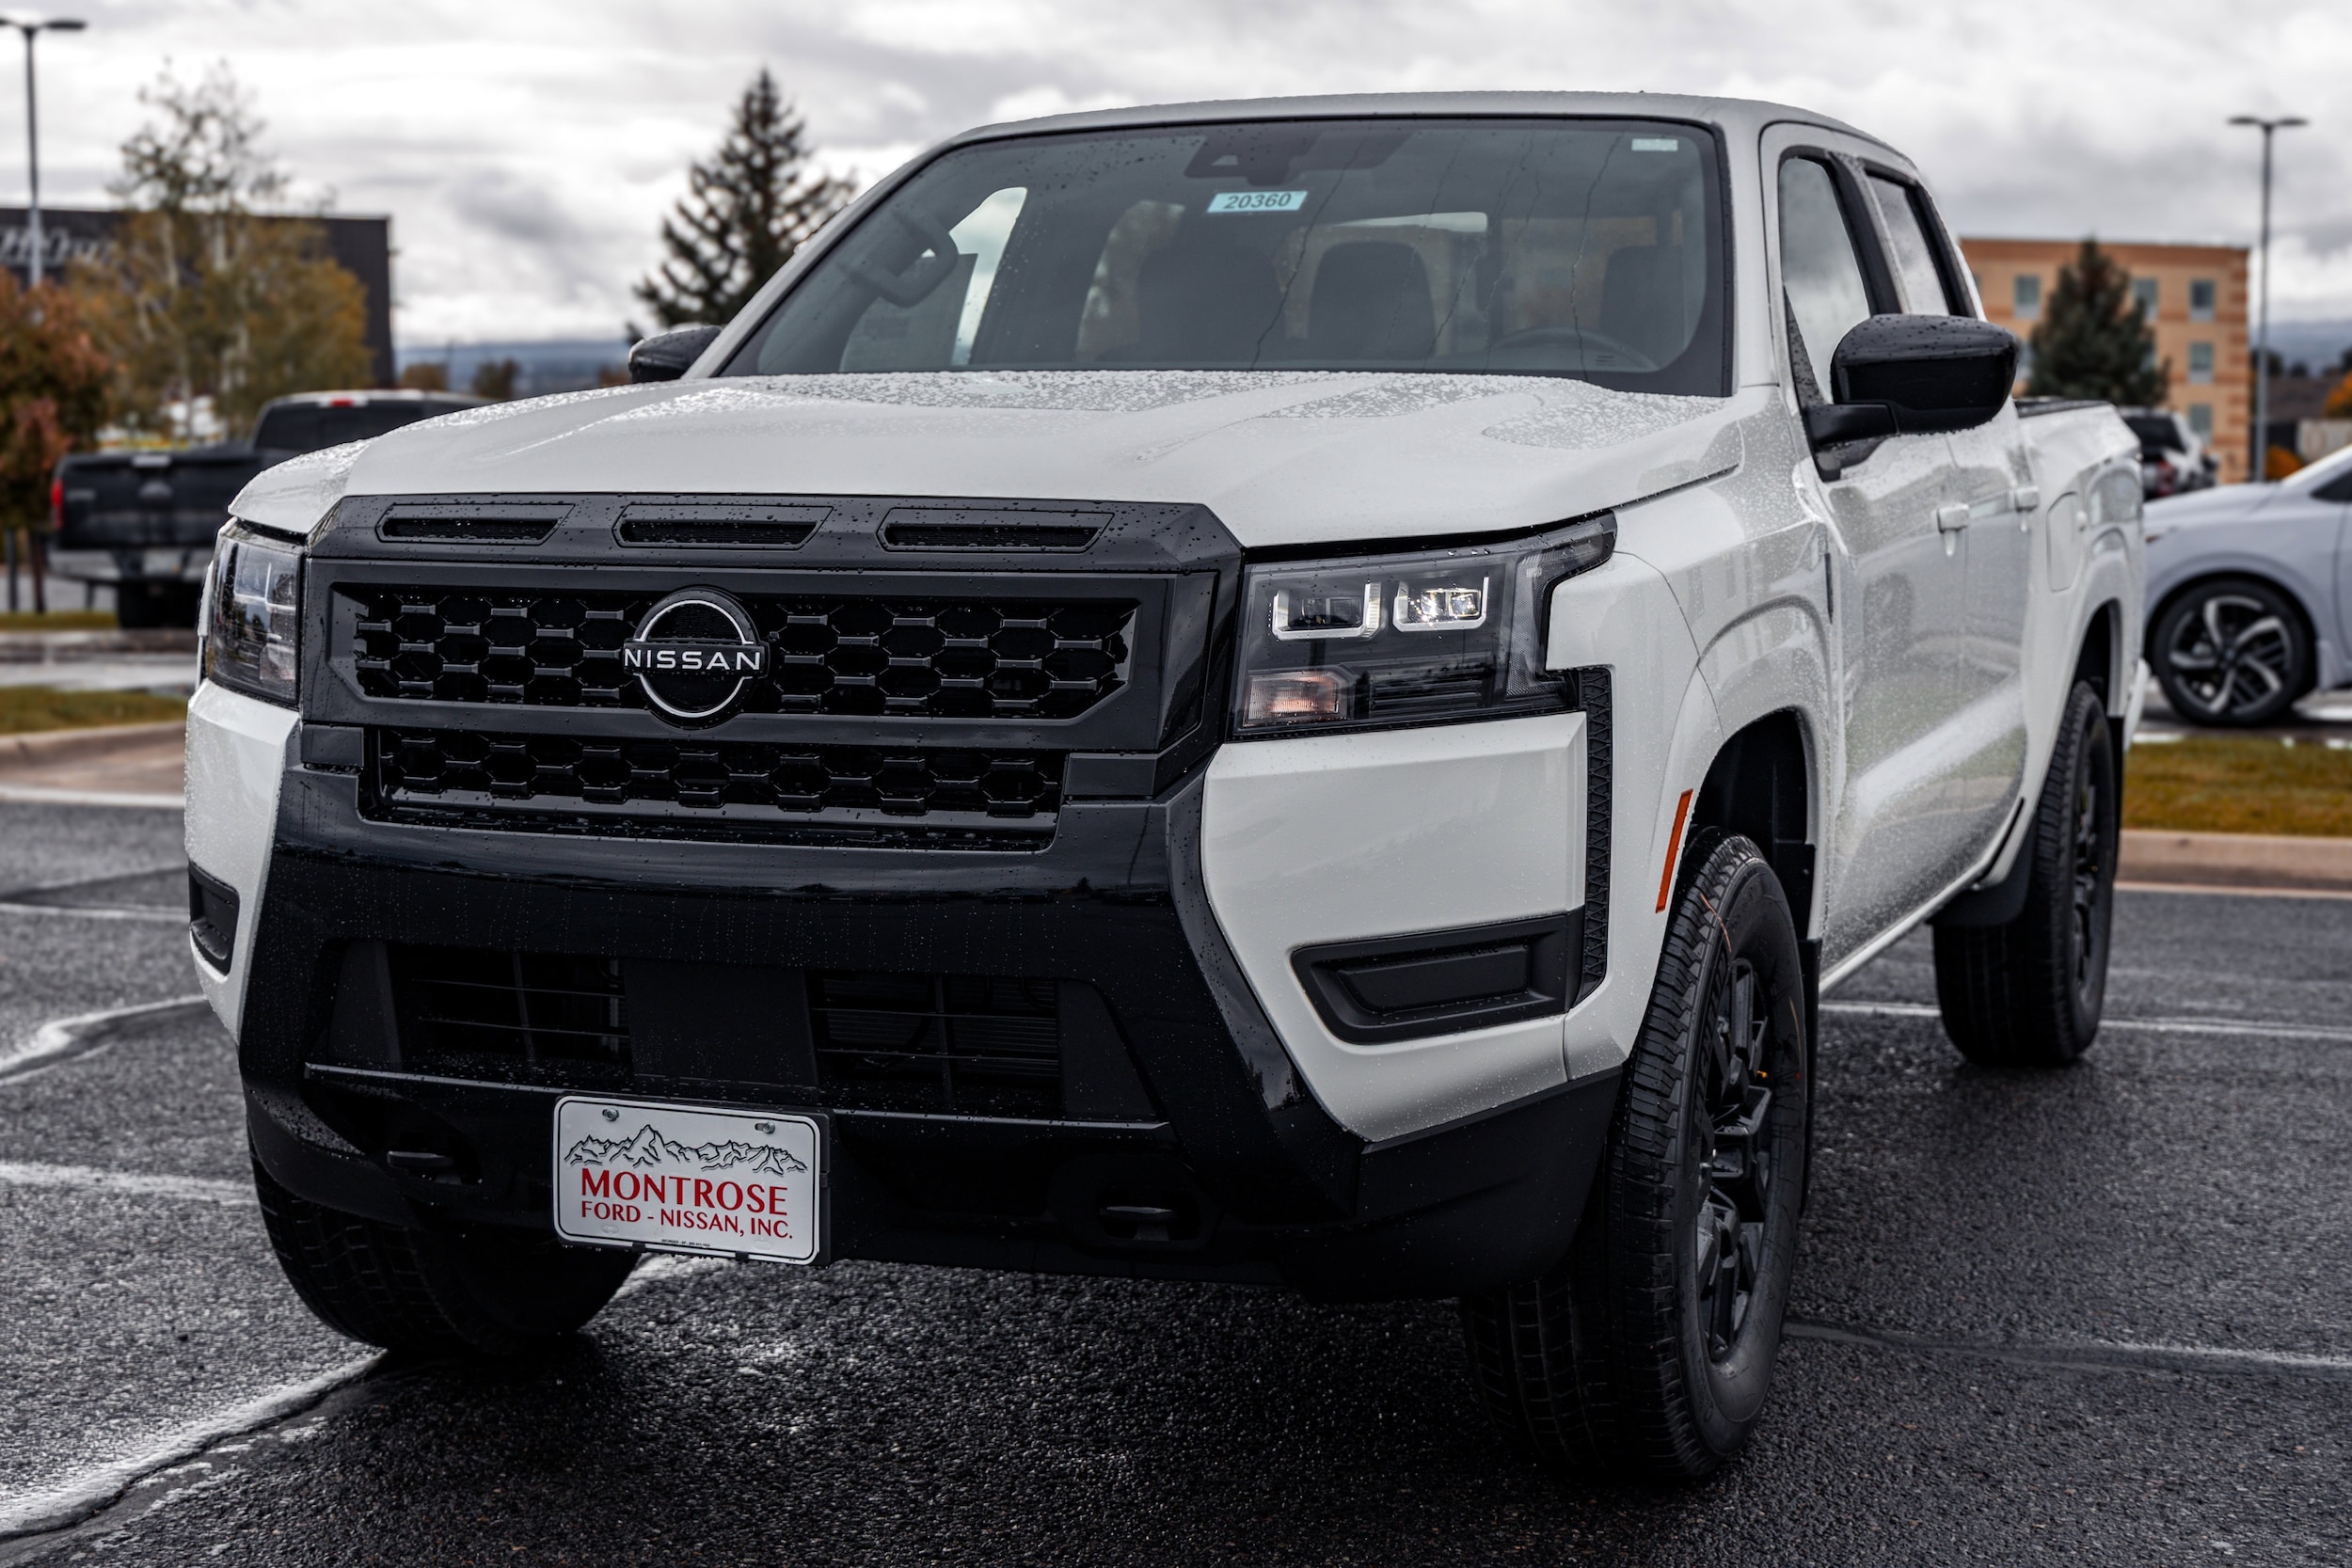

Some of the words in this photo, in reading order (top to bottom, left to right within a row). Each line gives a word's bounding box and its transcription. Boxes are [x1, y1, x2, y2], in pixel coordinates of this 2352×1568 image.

[1223, 192, 1293, 210] 20360
[624, 648, 761, 671] NISSAN
[581, 1167, 788, 1216] MONTROSE
[581, 1200, 641, 1223] FORD
[660, 1208, 744, 1237] NISSAN,
[750, 1217, 793, 1239] INC.
